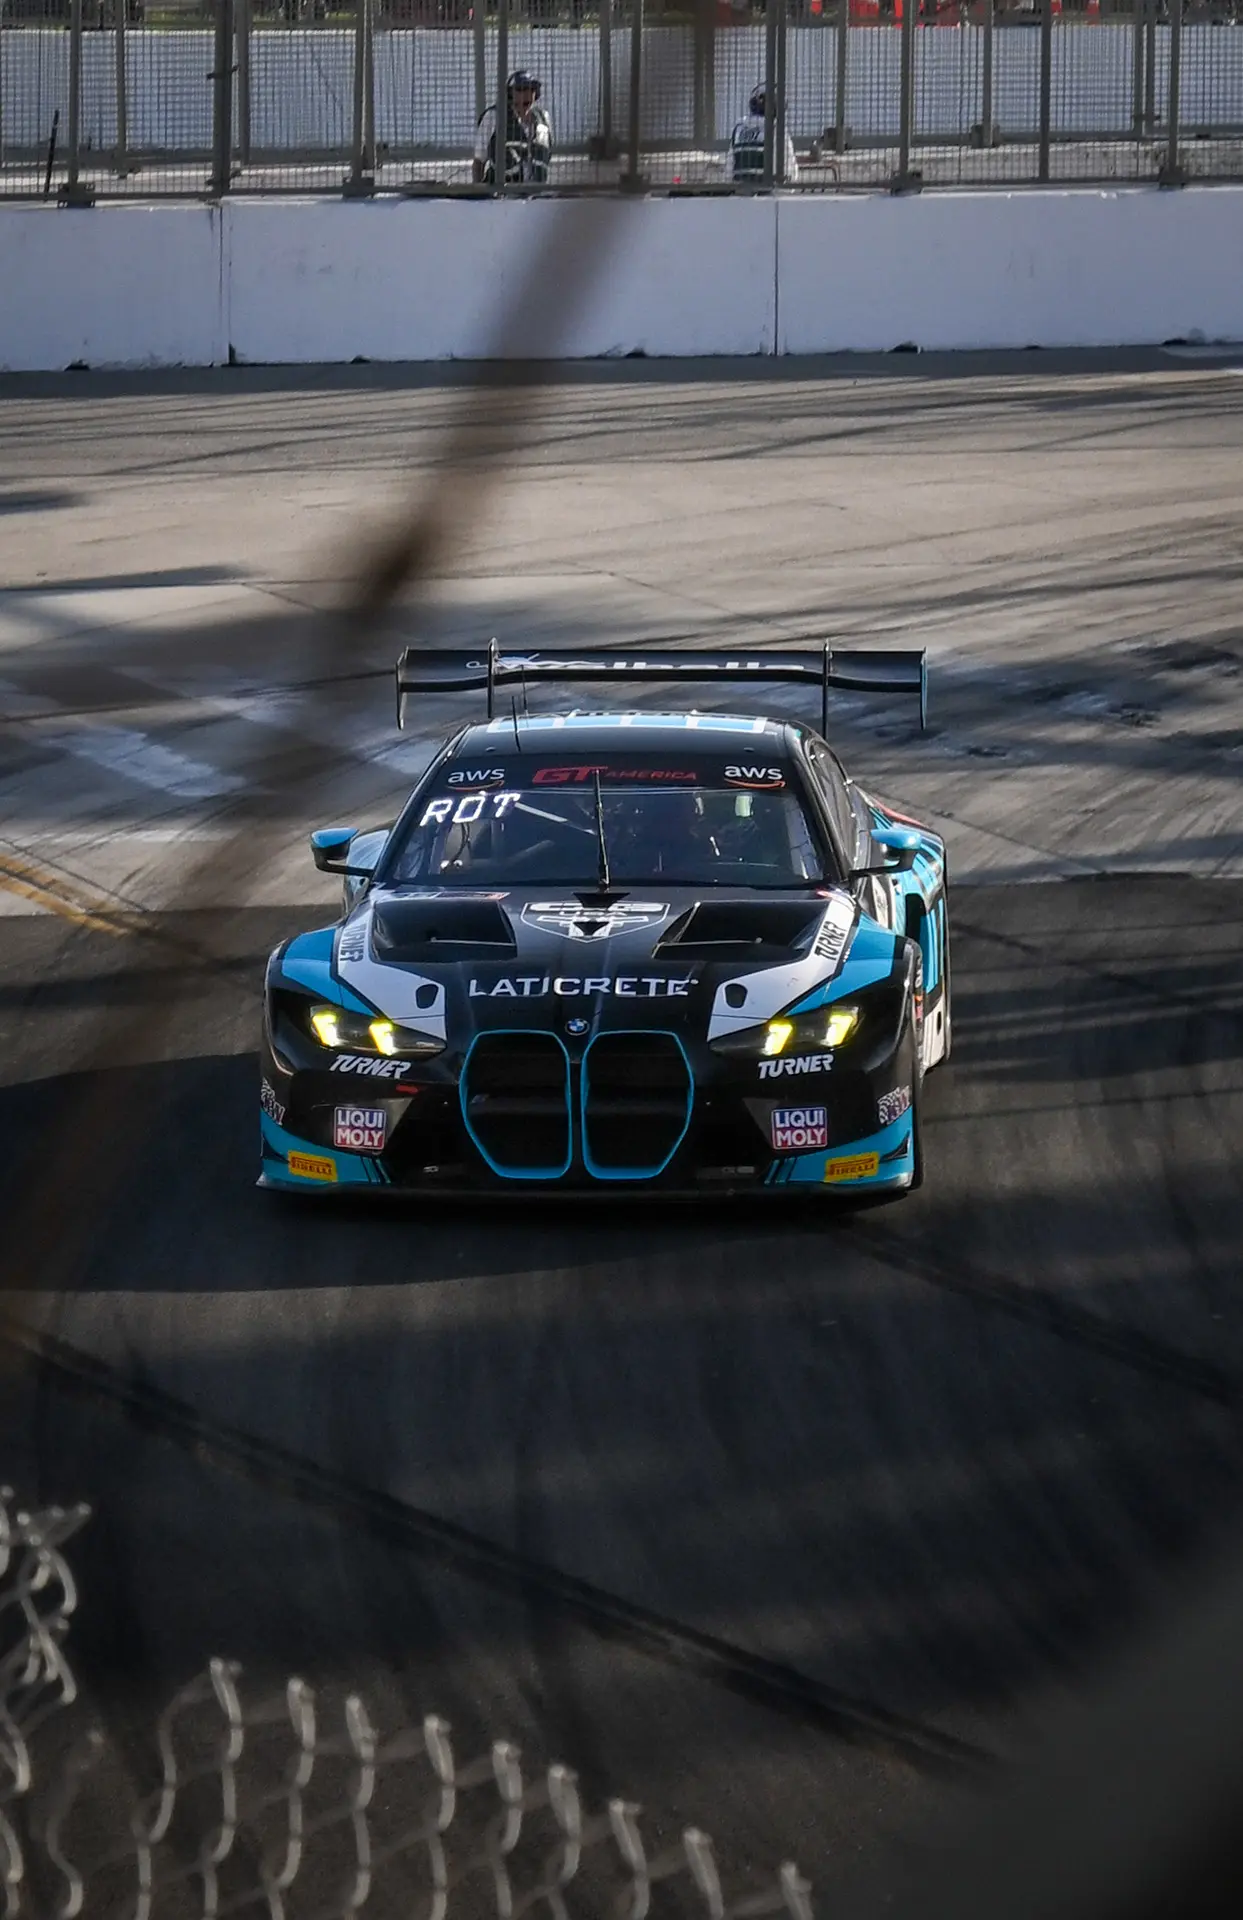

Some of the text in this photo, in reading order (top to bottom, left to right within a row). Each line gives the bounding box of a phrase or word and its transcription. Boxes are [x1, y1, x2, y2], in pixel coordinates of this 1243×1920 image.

[448, 768, 505, 783] aws
[532, 766, 697, 785] GT AMERICA
[724, 765, 783, 780] aws
[419, 792, 521, 827] ROT
[814, 920, 848, 961] TURNER
[468, 976, 689, 998] LATICRETE
[329, 1054, 412, 1080] TURNER
[758, 1053, 835, 1080] TURNER
[337, 1109, 383, 1129] LIQUI
[774, 1109, 824, 1128] LIQUI
[336, 1128, 383, 1147] MOLY
[775, 1127, 825, 1147] MOLY
